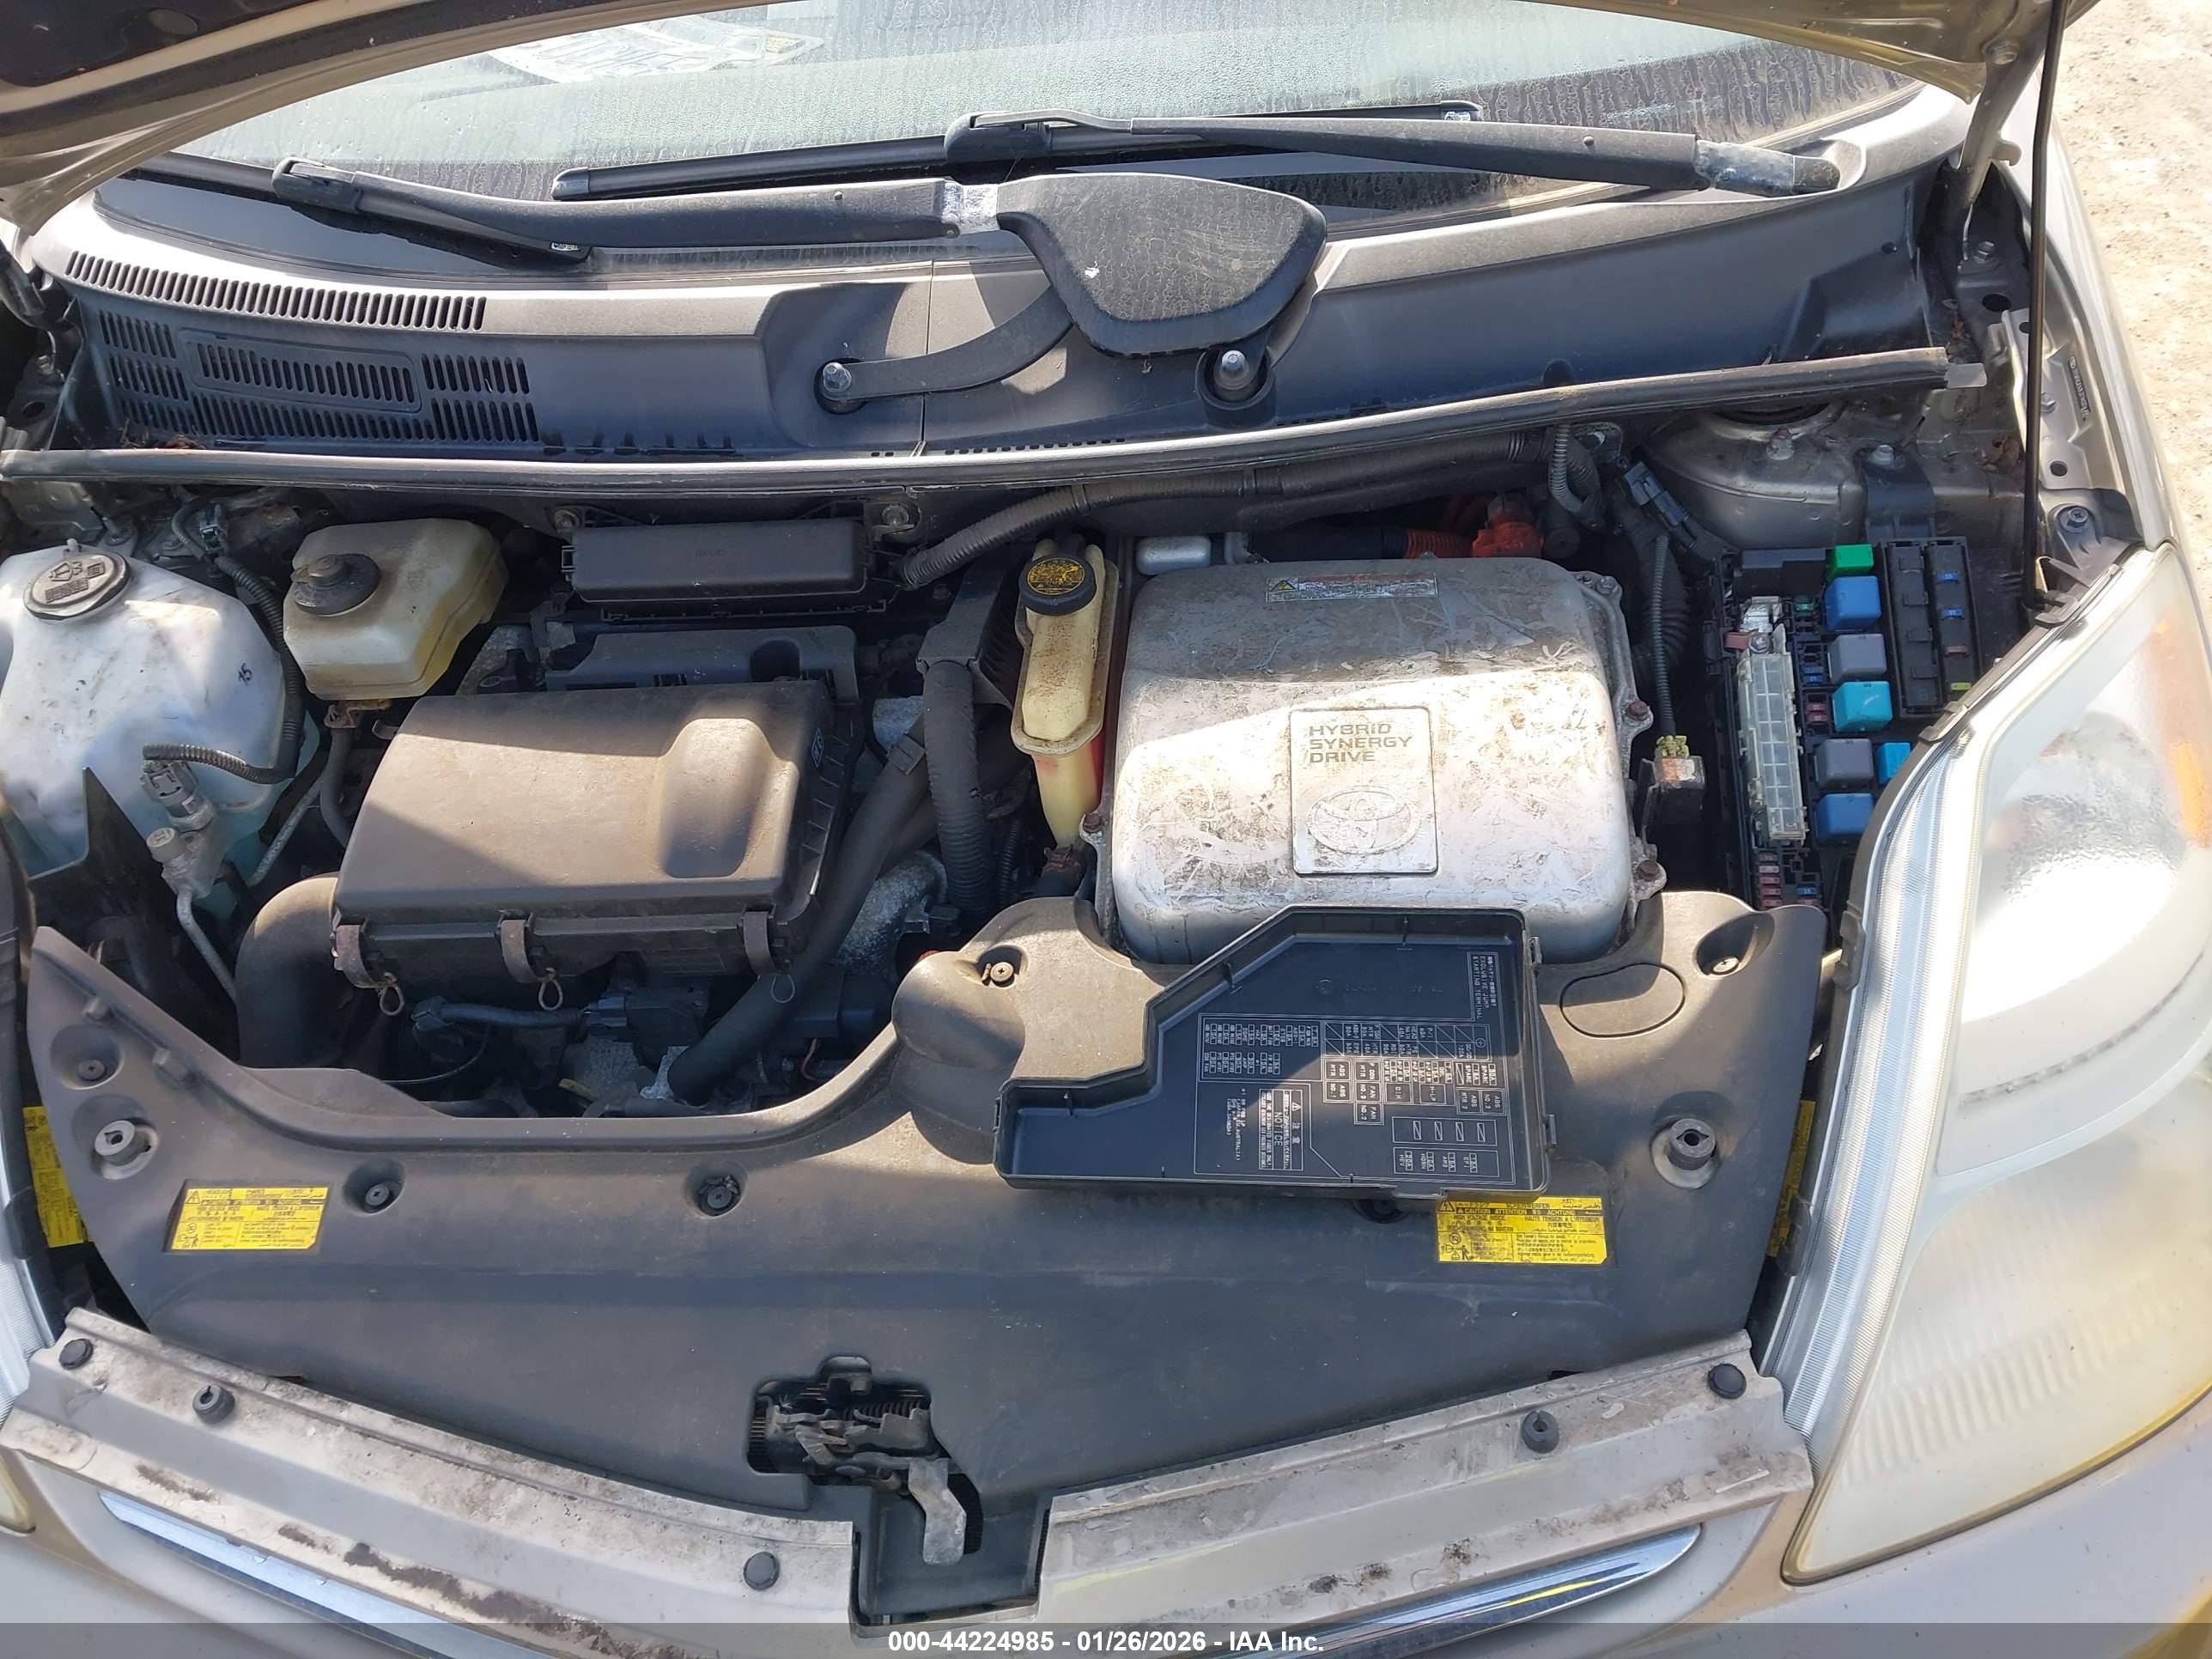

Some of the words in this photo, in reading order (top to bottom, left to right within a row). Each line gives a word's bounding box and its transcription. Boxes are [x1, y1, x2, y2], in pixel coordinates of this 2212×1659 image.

[1309, 724, 1391, 736] HYBRID
[1309, 736, 1413, 750] SYNERGY
[1309, 750, 1376, 763] DRIVE
[1472, 956, 1481, 986] STARTING
[1480, 956, 1489, 989] EXCLUSIVE
[1474, 989, 1483, 1019] TERMINAL
[1273, 1111, 1283, 1146] NOTICE
